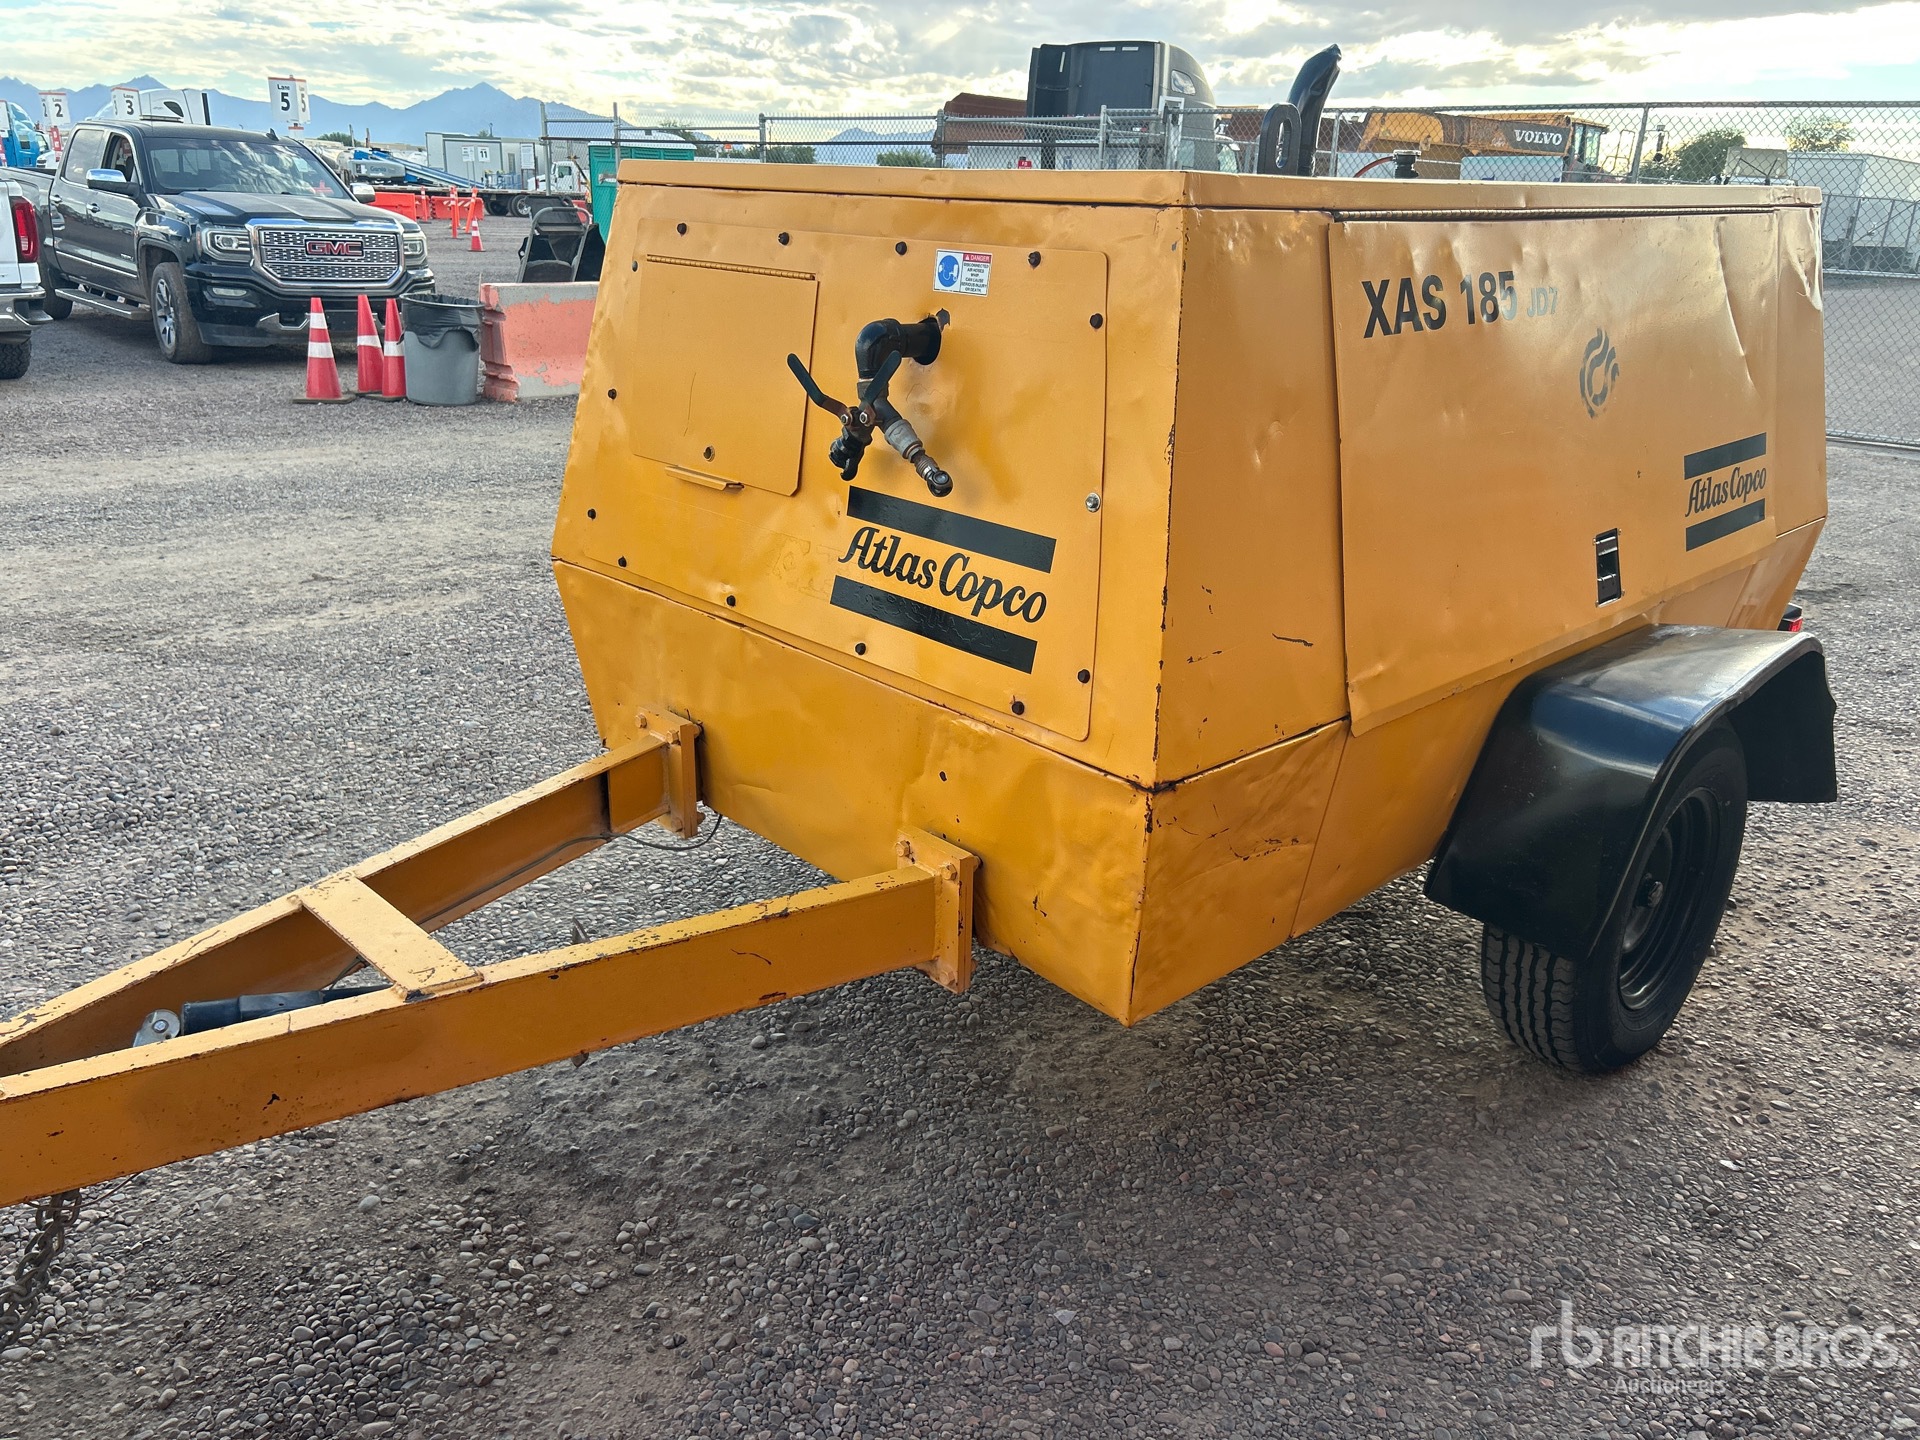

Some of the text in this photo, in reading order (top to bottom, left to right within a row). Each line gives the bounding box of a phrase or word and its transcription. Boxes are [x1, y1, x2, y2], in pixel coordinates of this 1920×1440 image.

[55, 103, 63, 117] 2
[125, 100, 134, 115] 3
[281, 92, 290, 111] 5
[301, 93, 306, 112] 5
[1514, 129, 1562, 146] VOLVO
[480, 150, 487, 158] 11
[307, 241, 362, 256] GMC
[1361, 274, 1447, 339] XAS
[1459, 270, 1518, 325] 185
[1685, 467, 1767, 518] Atlas Copco
[838, 526, 1047, 623] Atlas Copco
